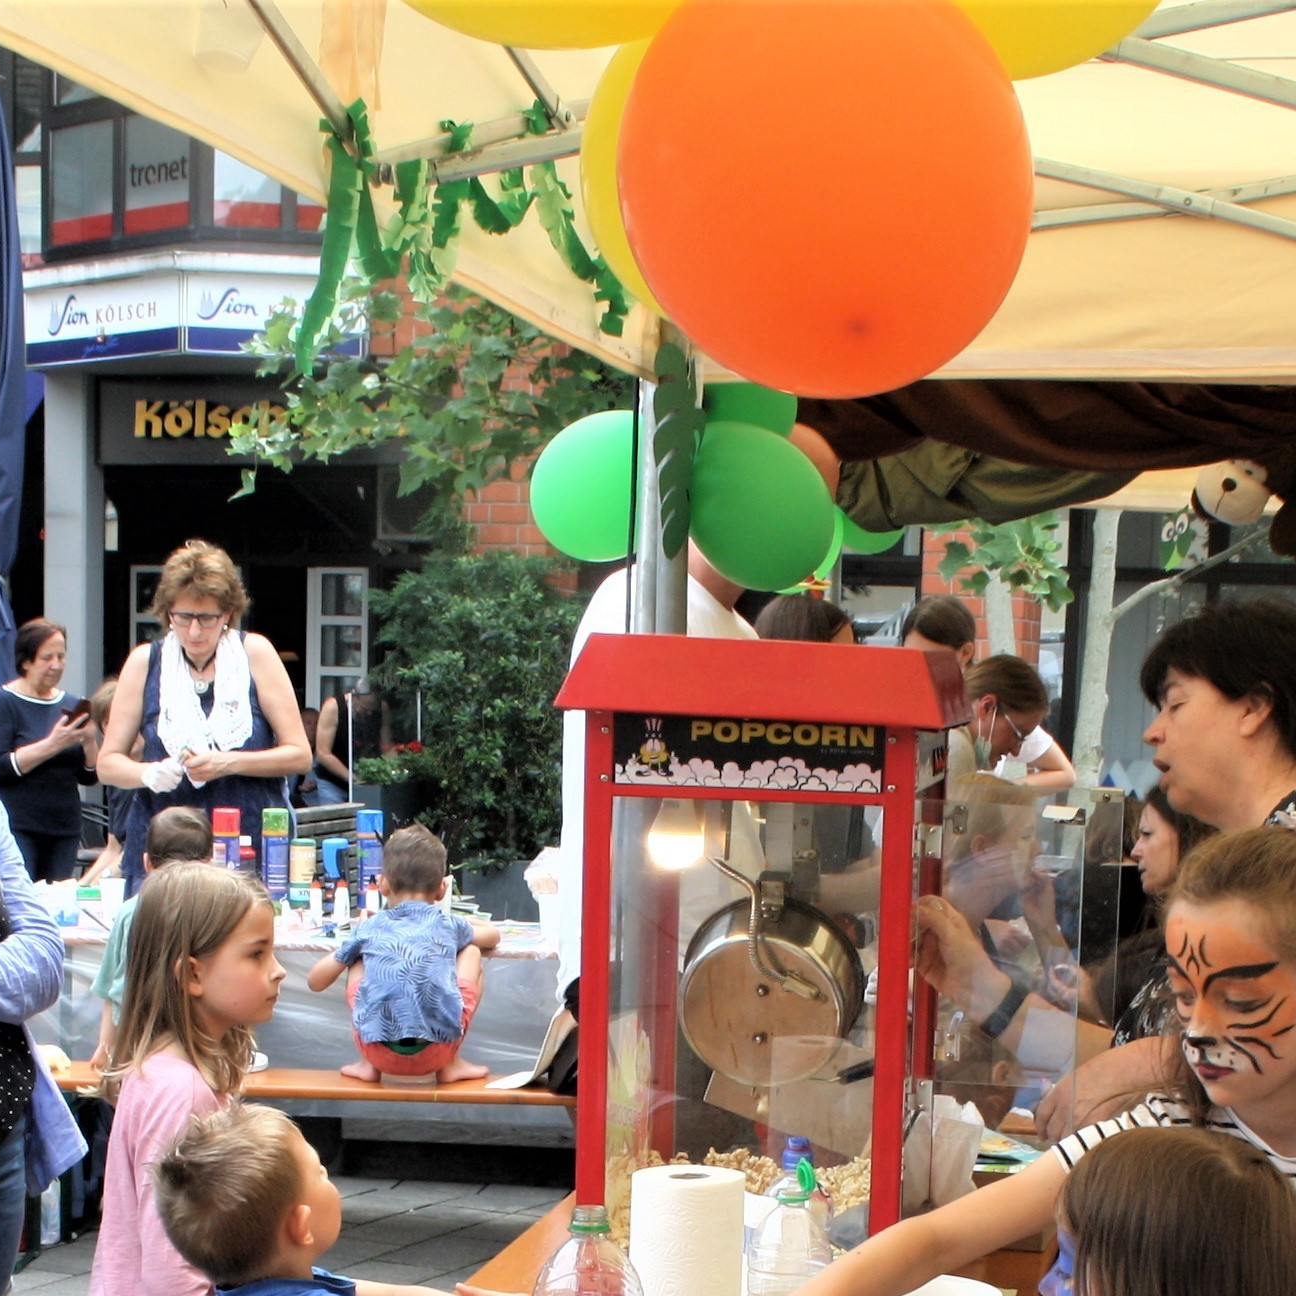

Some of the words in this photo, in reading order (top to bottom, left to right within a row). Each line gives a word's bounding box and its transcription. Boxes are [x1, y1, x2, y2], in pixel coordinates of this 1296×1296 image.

[47, 294, 89, 336] Sion
[95, 301, 157, 325] KÖLSCH
[197, 287, 259, 321] Sion
[690, 719, 875, 748] POPCORN
